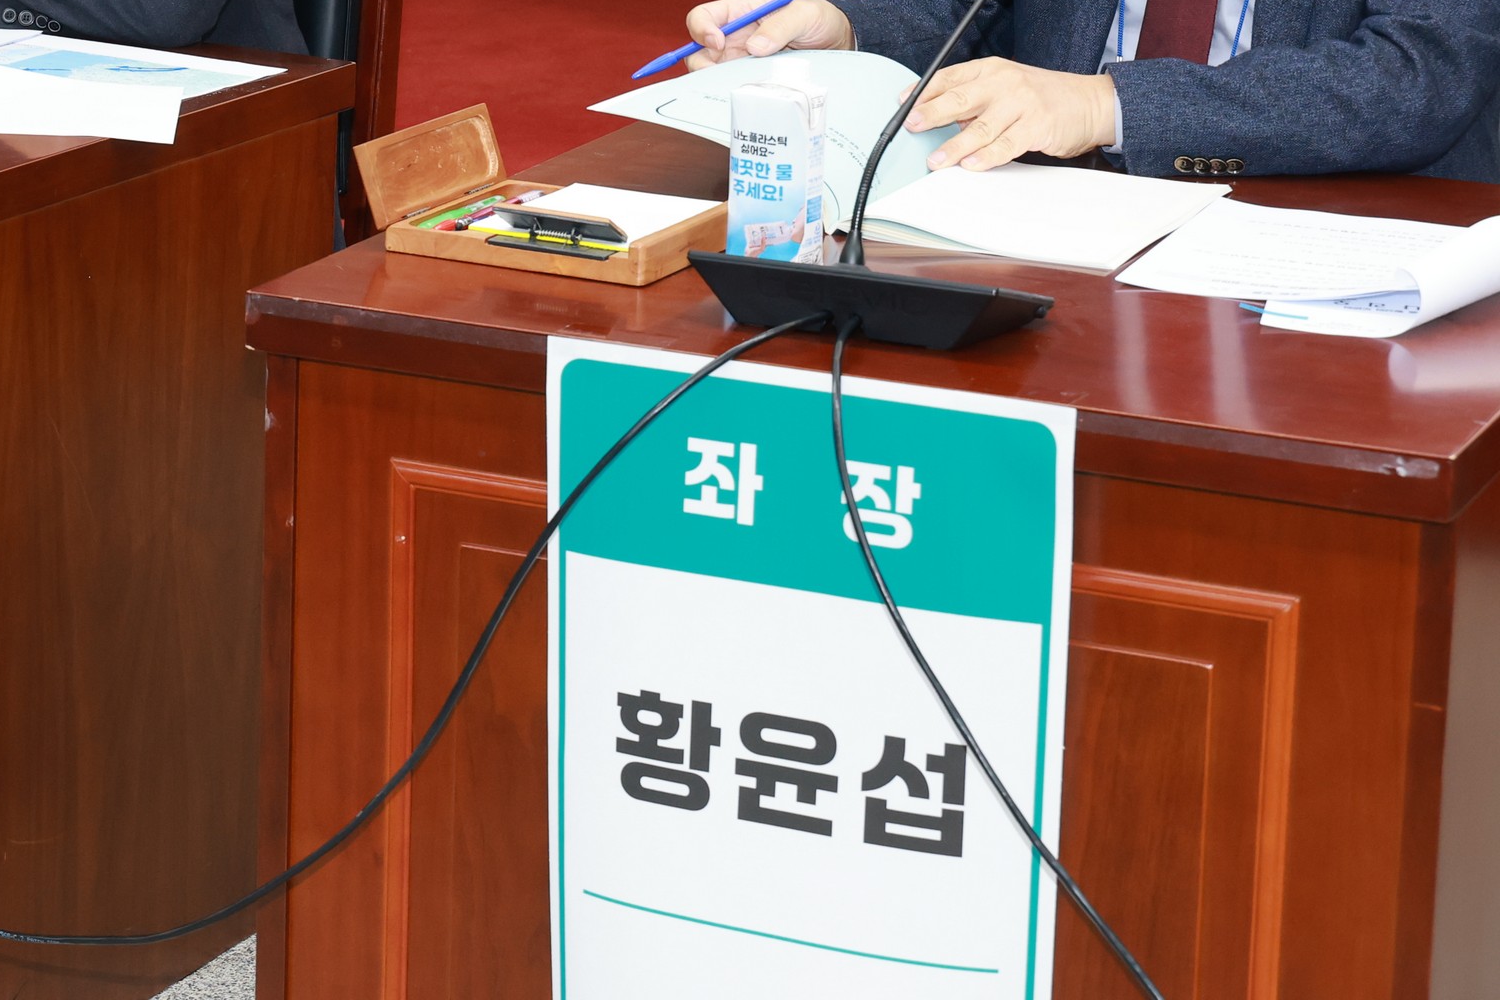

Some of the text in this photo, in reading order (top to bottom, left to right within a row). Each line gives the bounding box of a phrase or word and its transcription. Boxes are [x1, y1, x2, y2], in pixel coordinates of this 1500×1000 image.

[733, 128, 788, 147] 나노플라스틱
[775, 164, 793, 181] 물
[732, 178, 784, 201] 주세요!
[615, 688, 968, 858] 황윤섭
